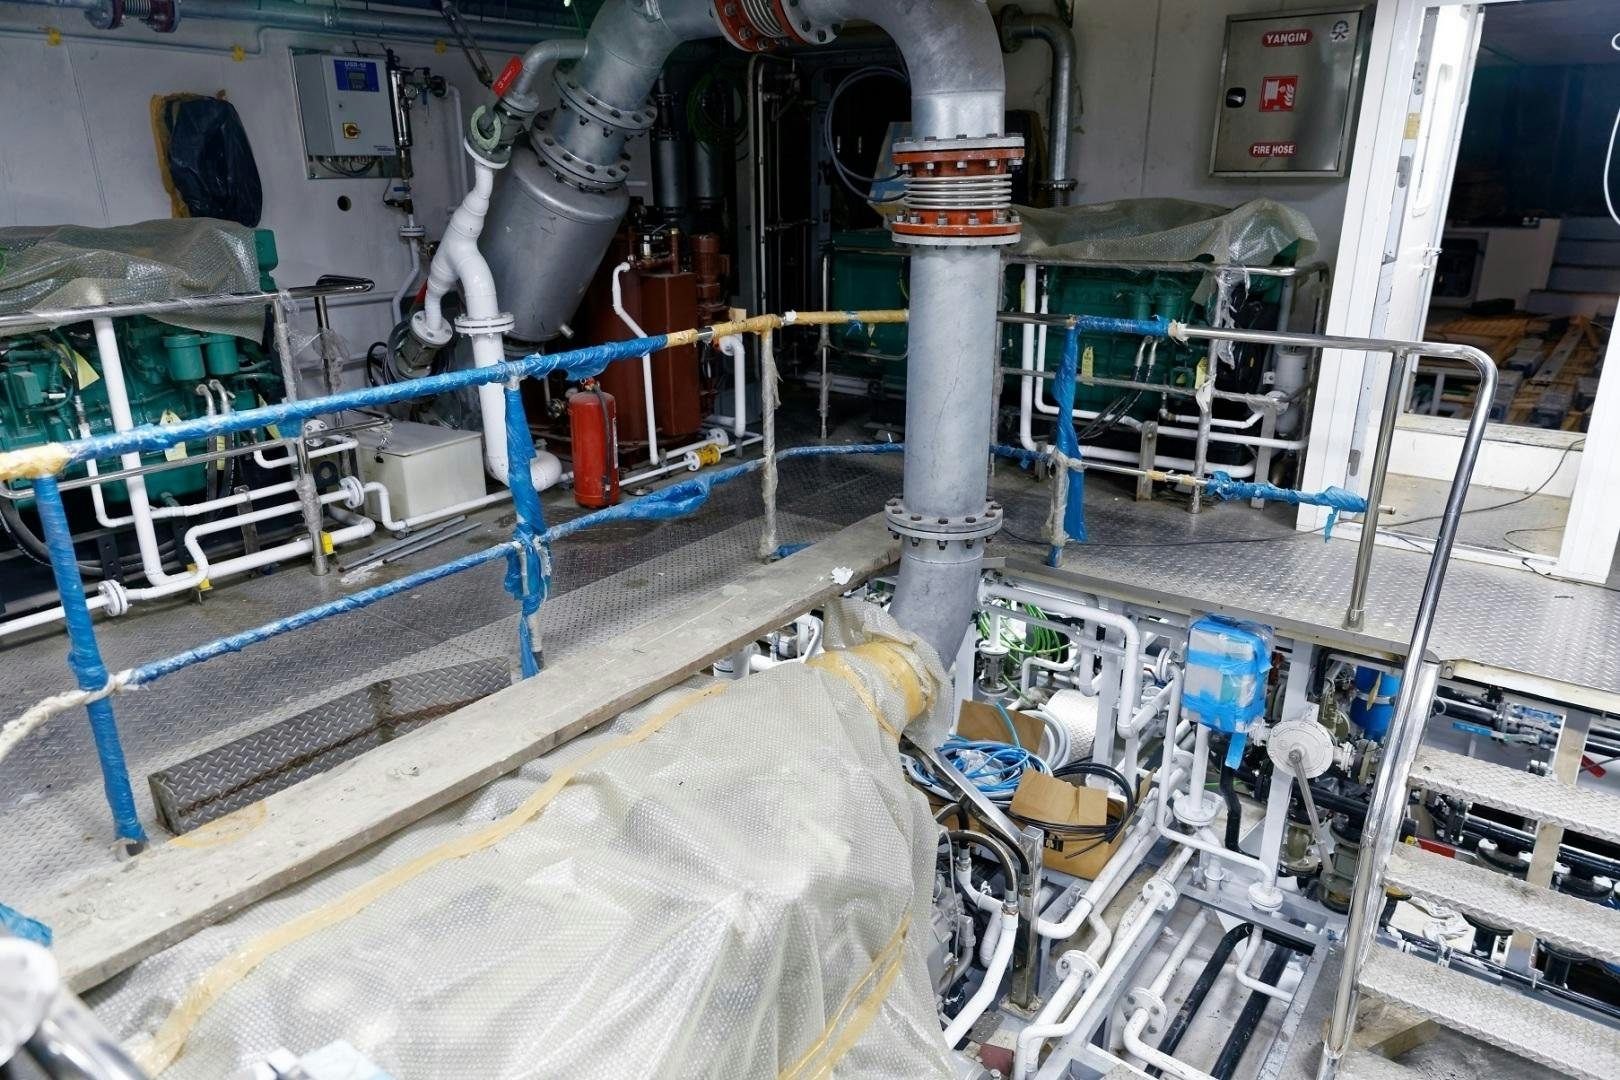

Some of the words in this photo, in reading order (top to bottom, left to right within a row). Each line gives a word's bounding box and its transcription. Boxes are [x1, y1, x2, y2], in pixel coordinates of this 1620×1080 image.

[1266, 32, 1307, 44] YANGIN
[1252, 145, 1270, 154] FIRE
[1272, 144, 1294, 154] HOSE
